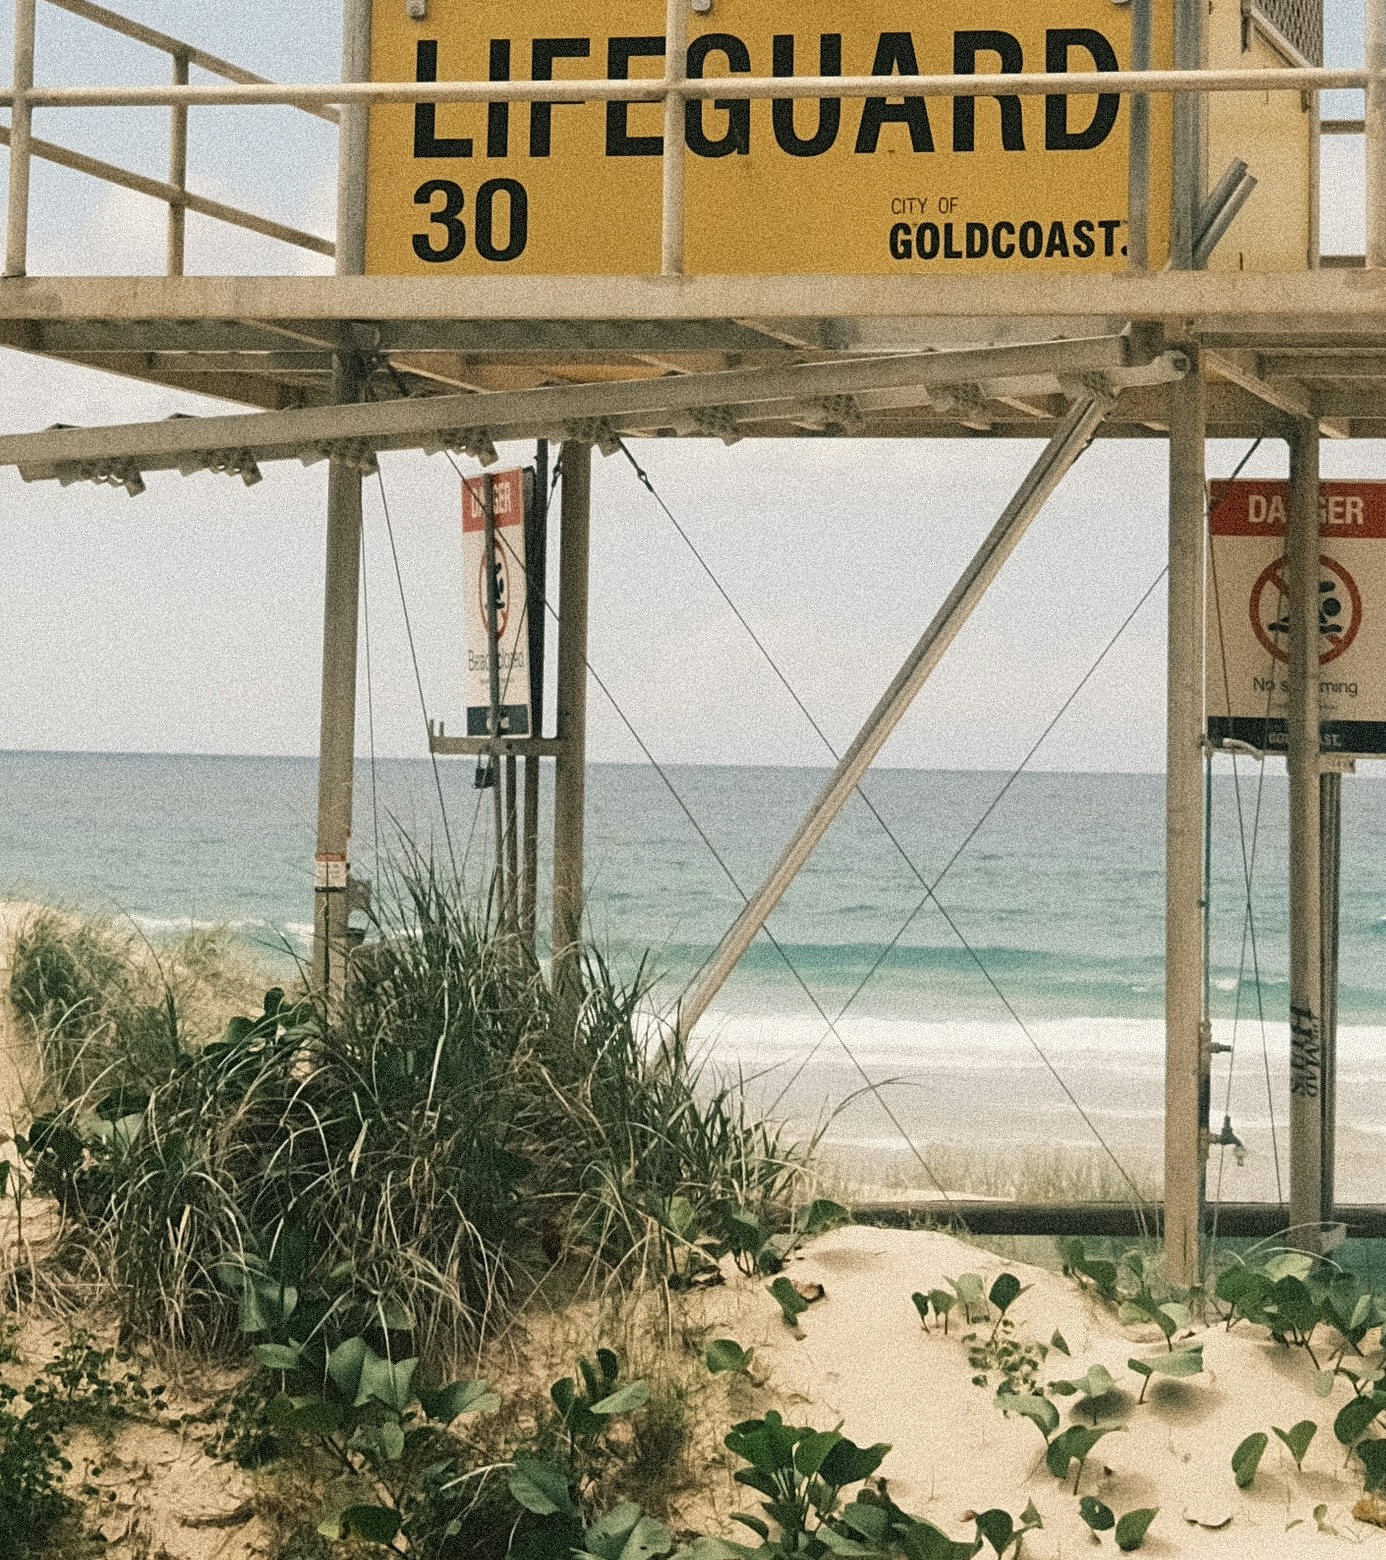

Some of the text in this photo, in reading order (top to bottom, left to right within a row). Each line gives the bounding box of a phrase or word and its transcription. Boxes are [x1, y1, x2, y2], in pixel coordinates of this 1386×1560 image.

[414, 27, 1121, 159] LIFEGUARD
[413, 177, 528, 264] 30
[891, 196, 959, 215] CITY OF
[1248, 494, 1364, 525] DAER
[1253, 678, 1358, 697] No sming
